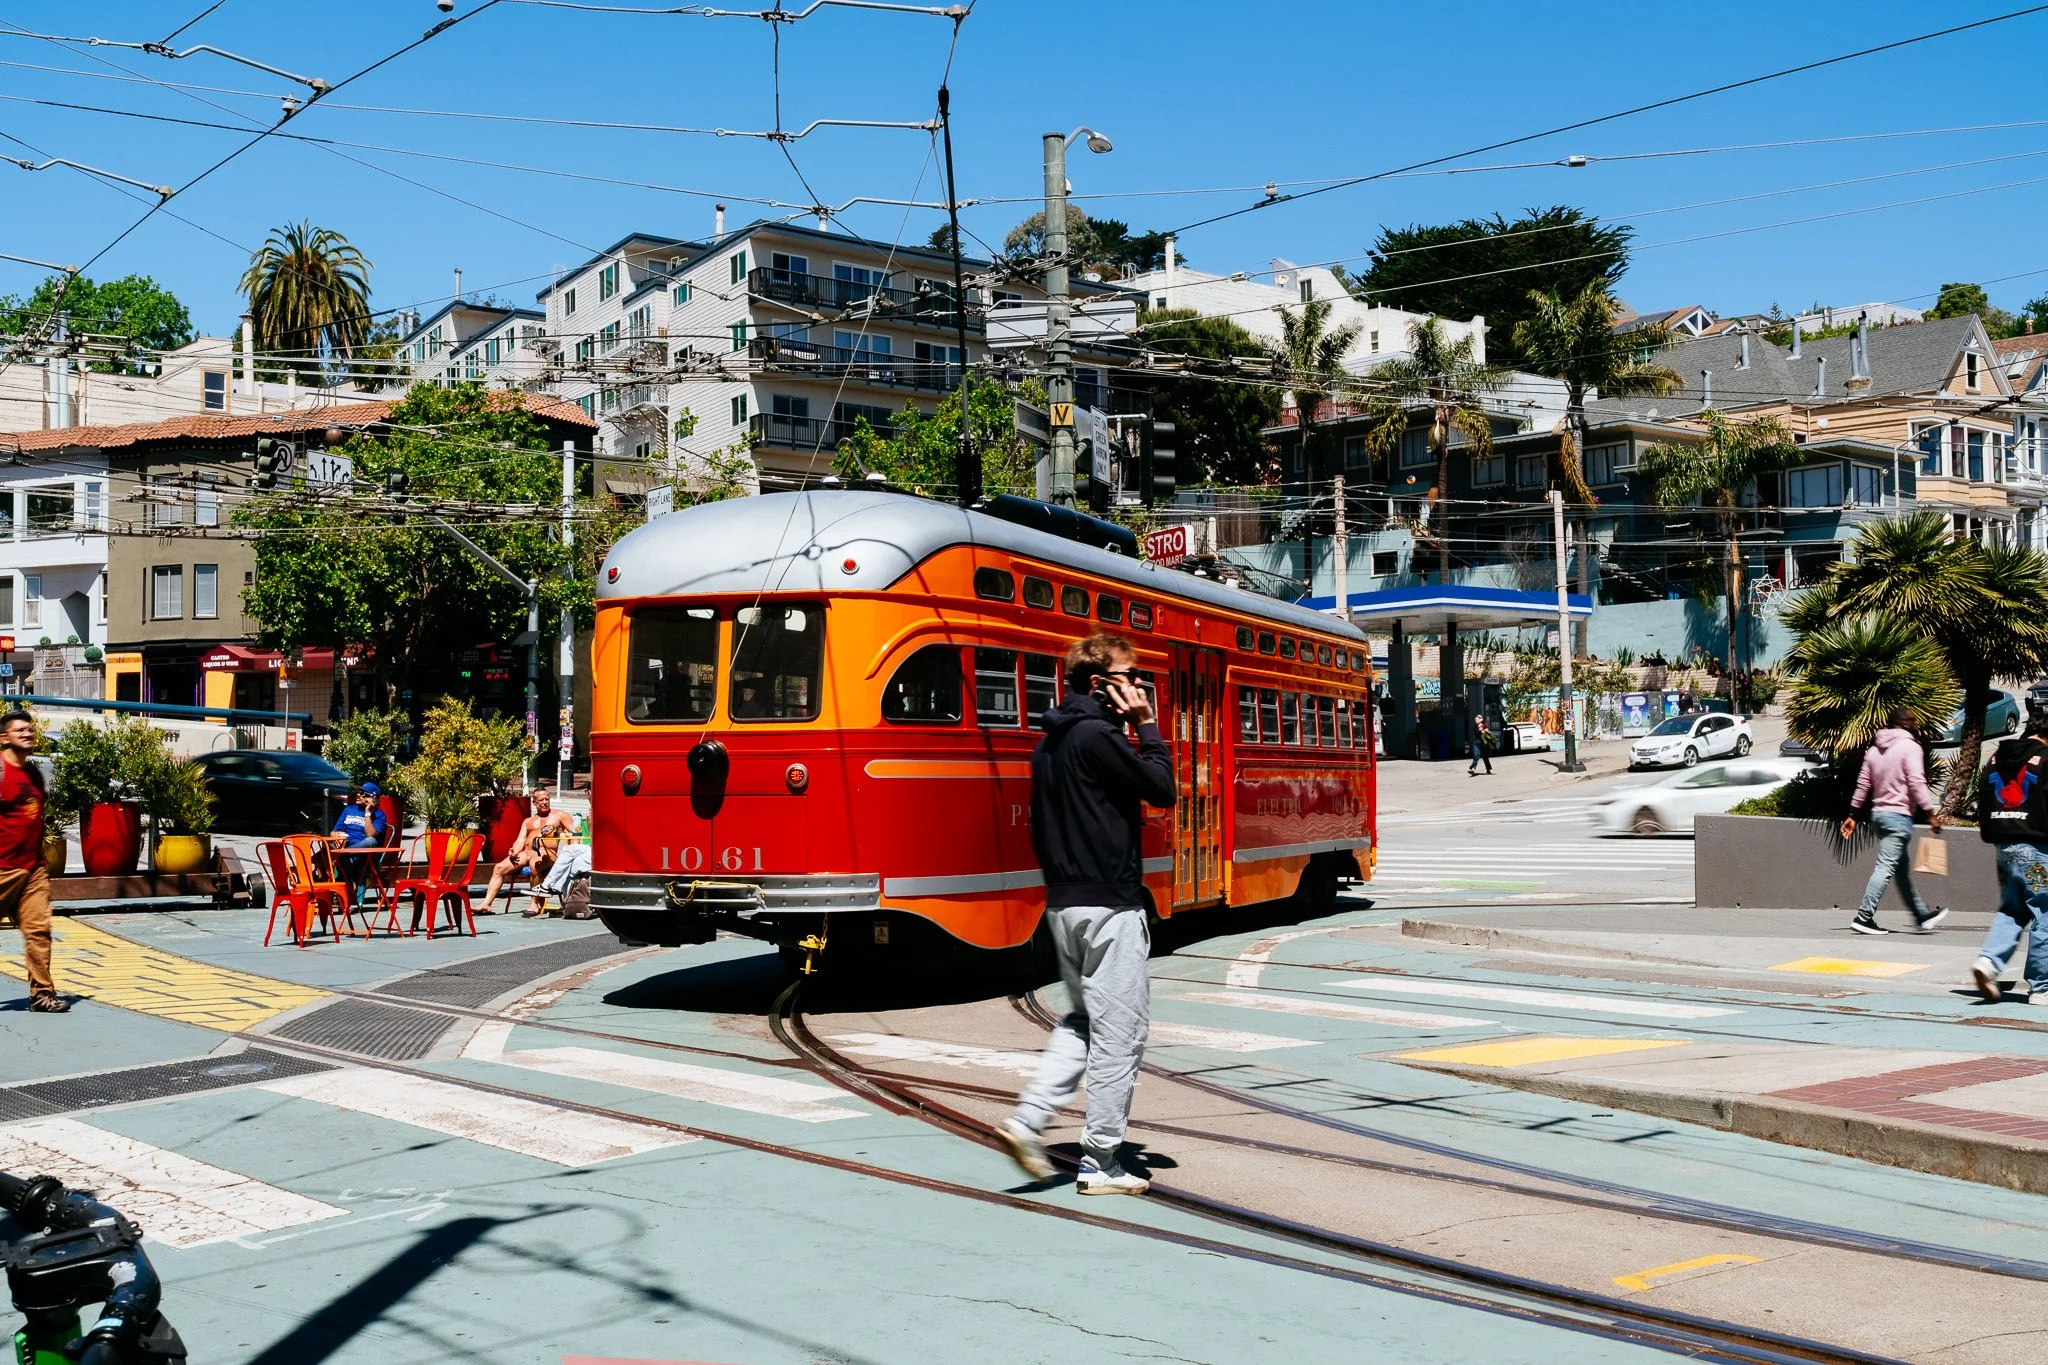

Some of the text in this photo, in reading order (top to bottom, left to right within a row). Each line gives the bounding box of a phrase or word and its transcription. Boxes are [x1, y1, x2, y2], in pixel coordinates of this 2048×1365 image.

[1095, 430, 1107, 447] GREEN
[1095, 445, 1108, 460] ARROW
[1096, 461, 1107, 476] ONLY
[660, 492, 671, 505] LANE
[1165, 553, 1184, 566] MART
[202, 661, 221, 669] LIQUOR
[1257, 797, 1301, 816] ELECTRIC
[660, 846, 765, 871] 1061
